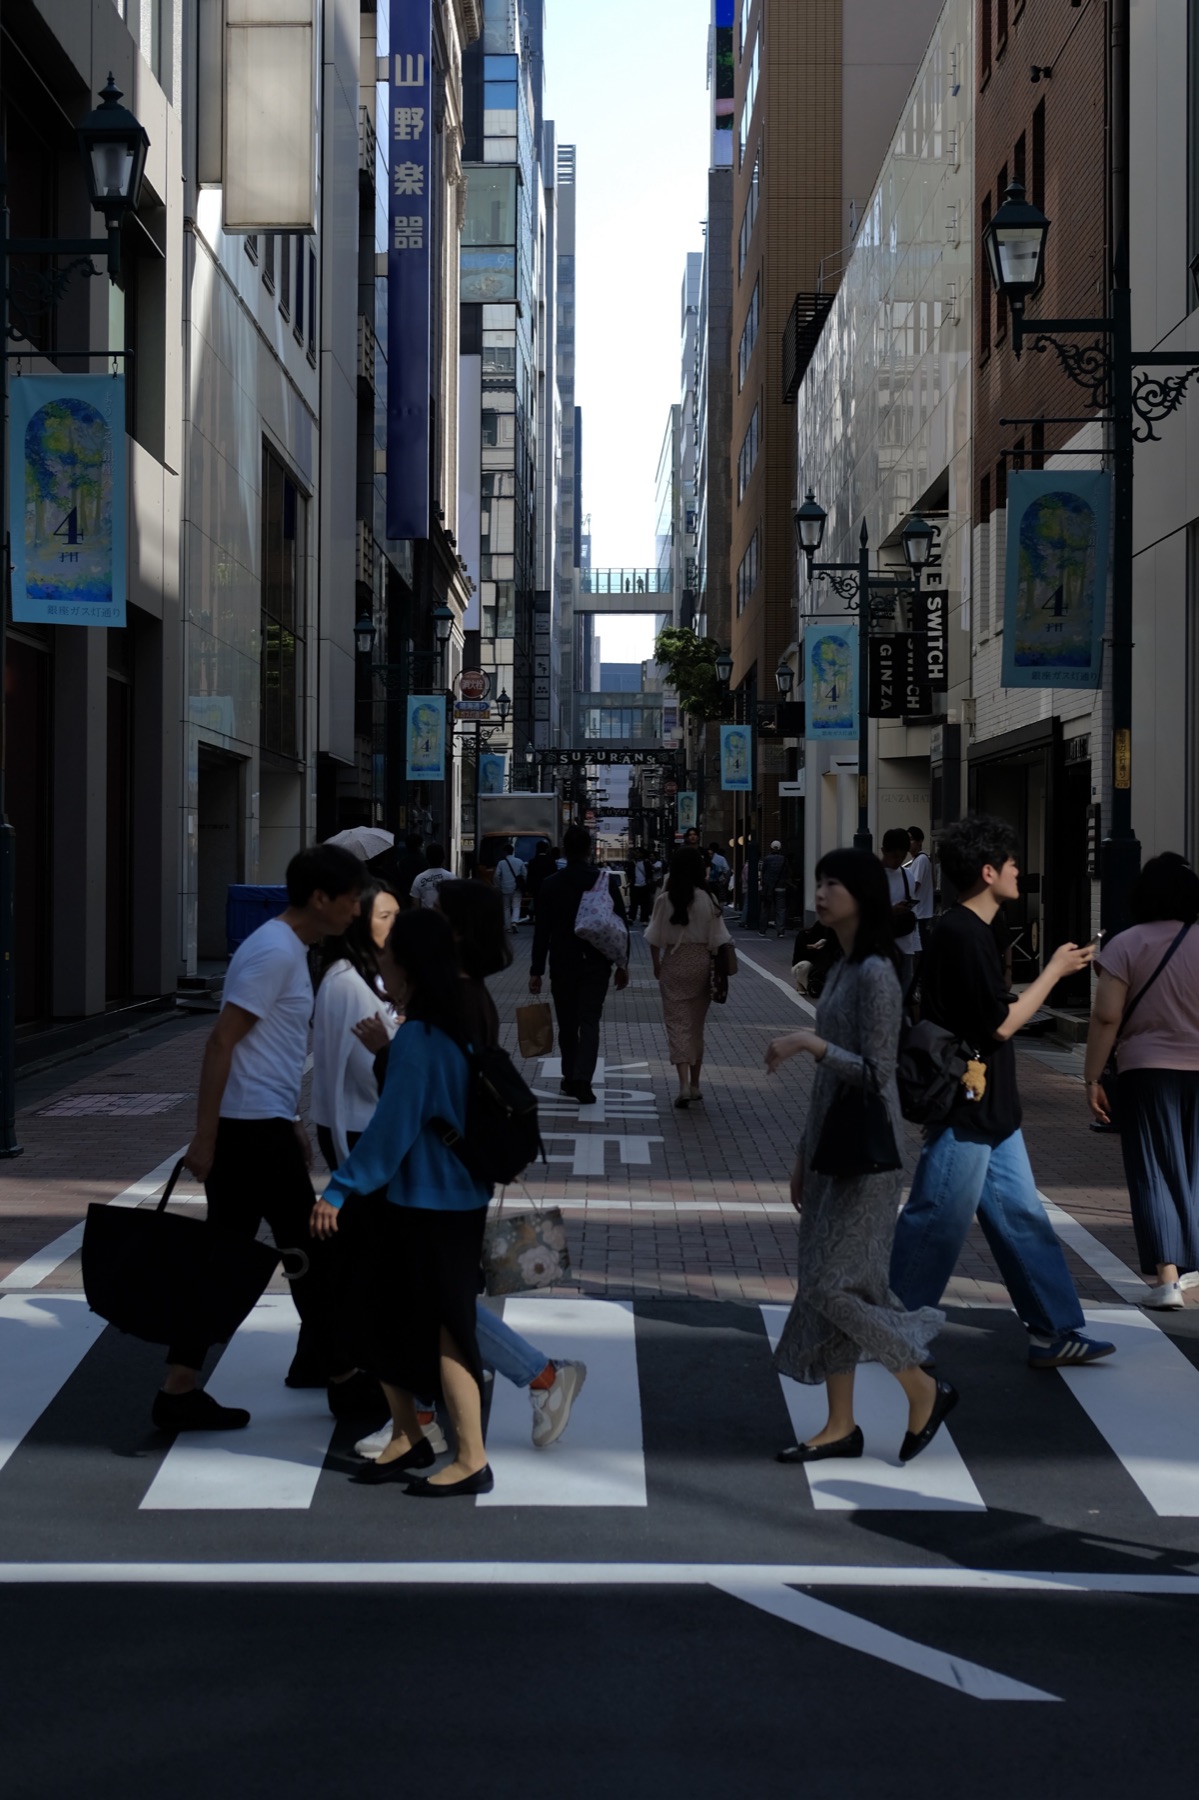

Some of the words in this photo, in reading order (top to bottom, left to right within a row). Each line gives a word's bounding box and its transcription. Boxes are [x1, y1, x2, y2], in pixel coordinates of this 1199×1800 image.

[393, 52, 425, 250] 山野楽器
[53, 506, 84, 545] 4
[1041, 583, 1069, 617] 4
[47, 604, 121, 619] 銀座ガス灯通り
[926, 596, 944, 679] SWITCH
[461, 679, 484, 690] 消火栓
[879, 643, 893, 712] GINZA
[1031, 670, 1097, 682] 銀座ガス灯通り
[824, 684, 840, 703] 4
[420, 738, 432, 753] 4
[559, 751, 644, 765] SUZURAN
[880, 794, 911, 804] GINZA
